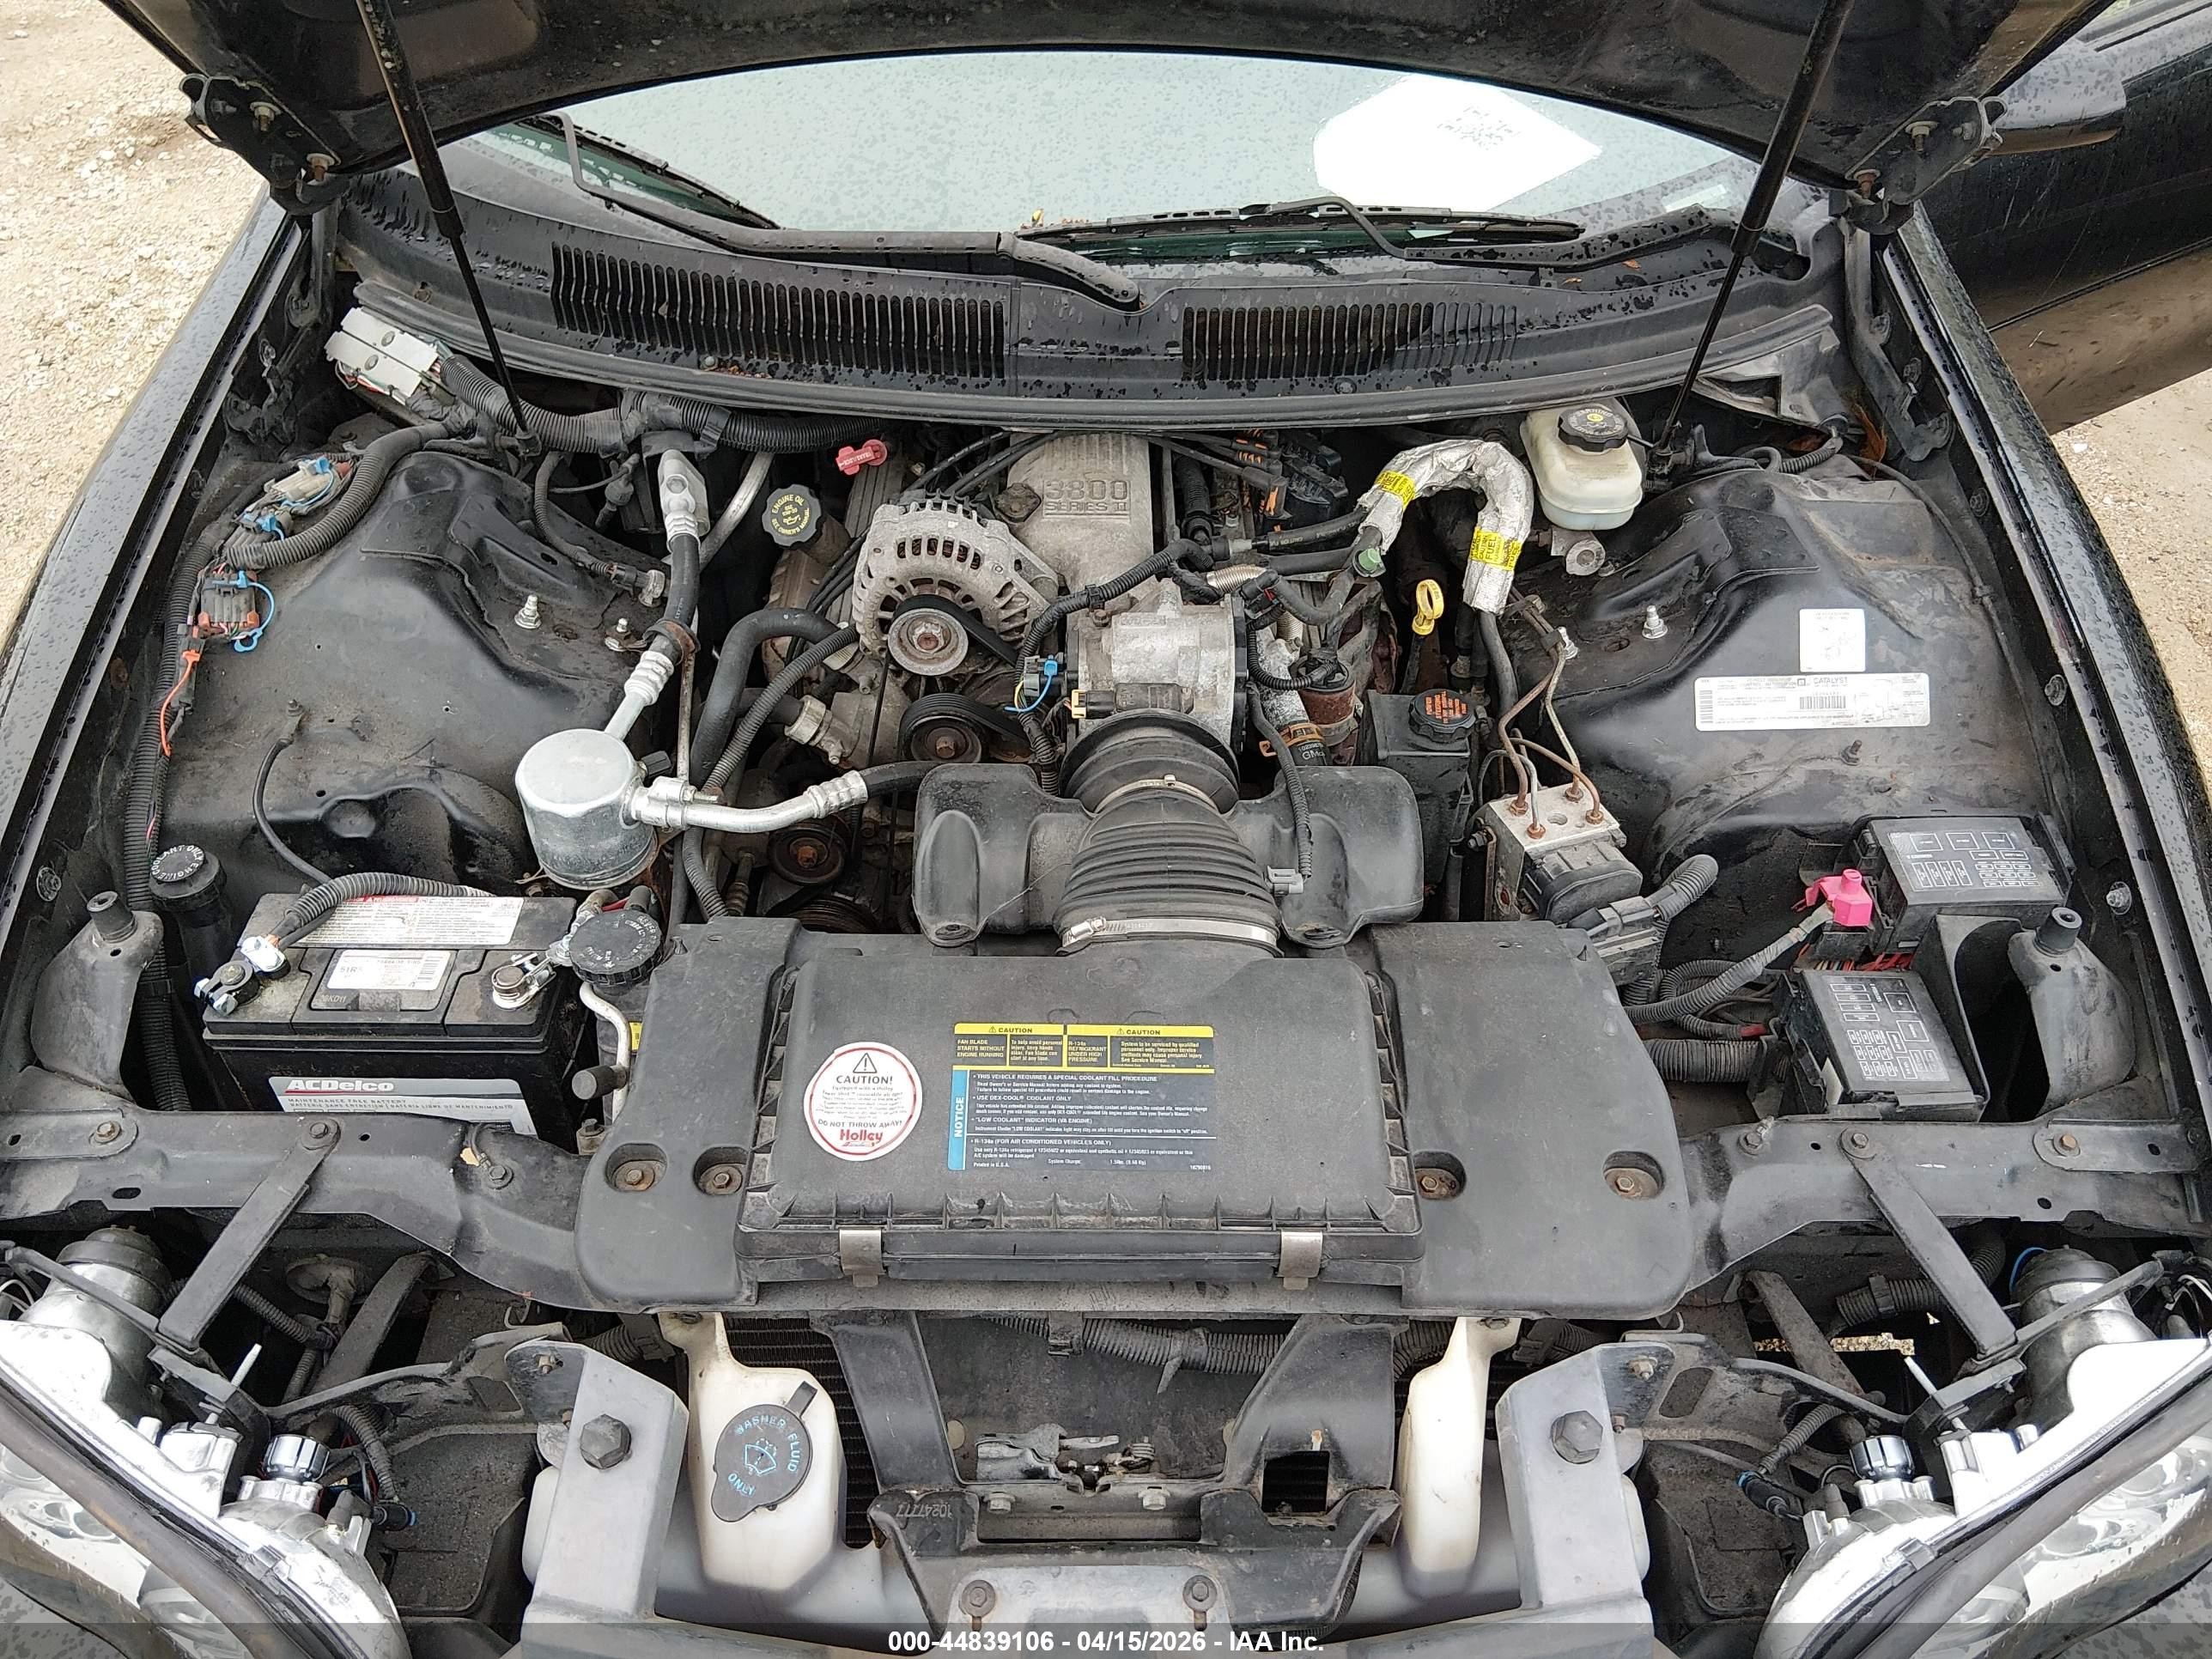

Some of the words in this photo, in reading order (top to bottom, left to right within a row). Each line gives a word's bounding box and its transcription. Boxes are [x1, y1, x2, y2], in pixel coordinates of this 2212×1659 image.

[1045, 480, 1127, 500] 3800
[772, 494, 794, 514] ENGINE
[795, 495, 804, 506] OIL
[1045, 501, 1108, 512] SERIES
[1486, 537, 1497, 560] FUEL
[151, 845, 185, 875] COOLANT
[187, 845, 204, 861] ONLY
[158, 862, 199, 880] ENGINE
[286, 1079, 394, 1092] ACDelco
[836, 1075, 893, 1085] CAUTION!
[954, 1097, 964, 1138] NOTICE
[839, 1129, 883, 1144] Holley
[735, 1415, 787, 1435] WASHER
[787, 1433, 800, 1472] FLUID
[728, 1473, 756, 1495] ONLY
